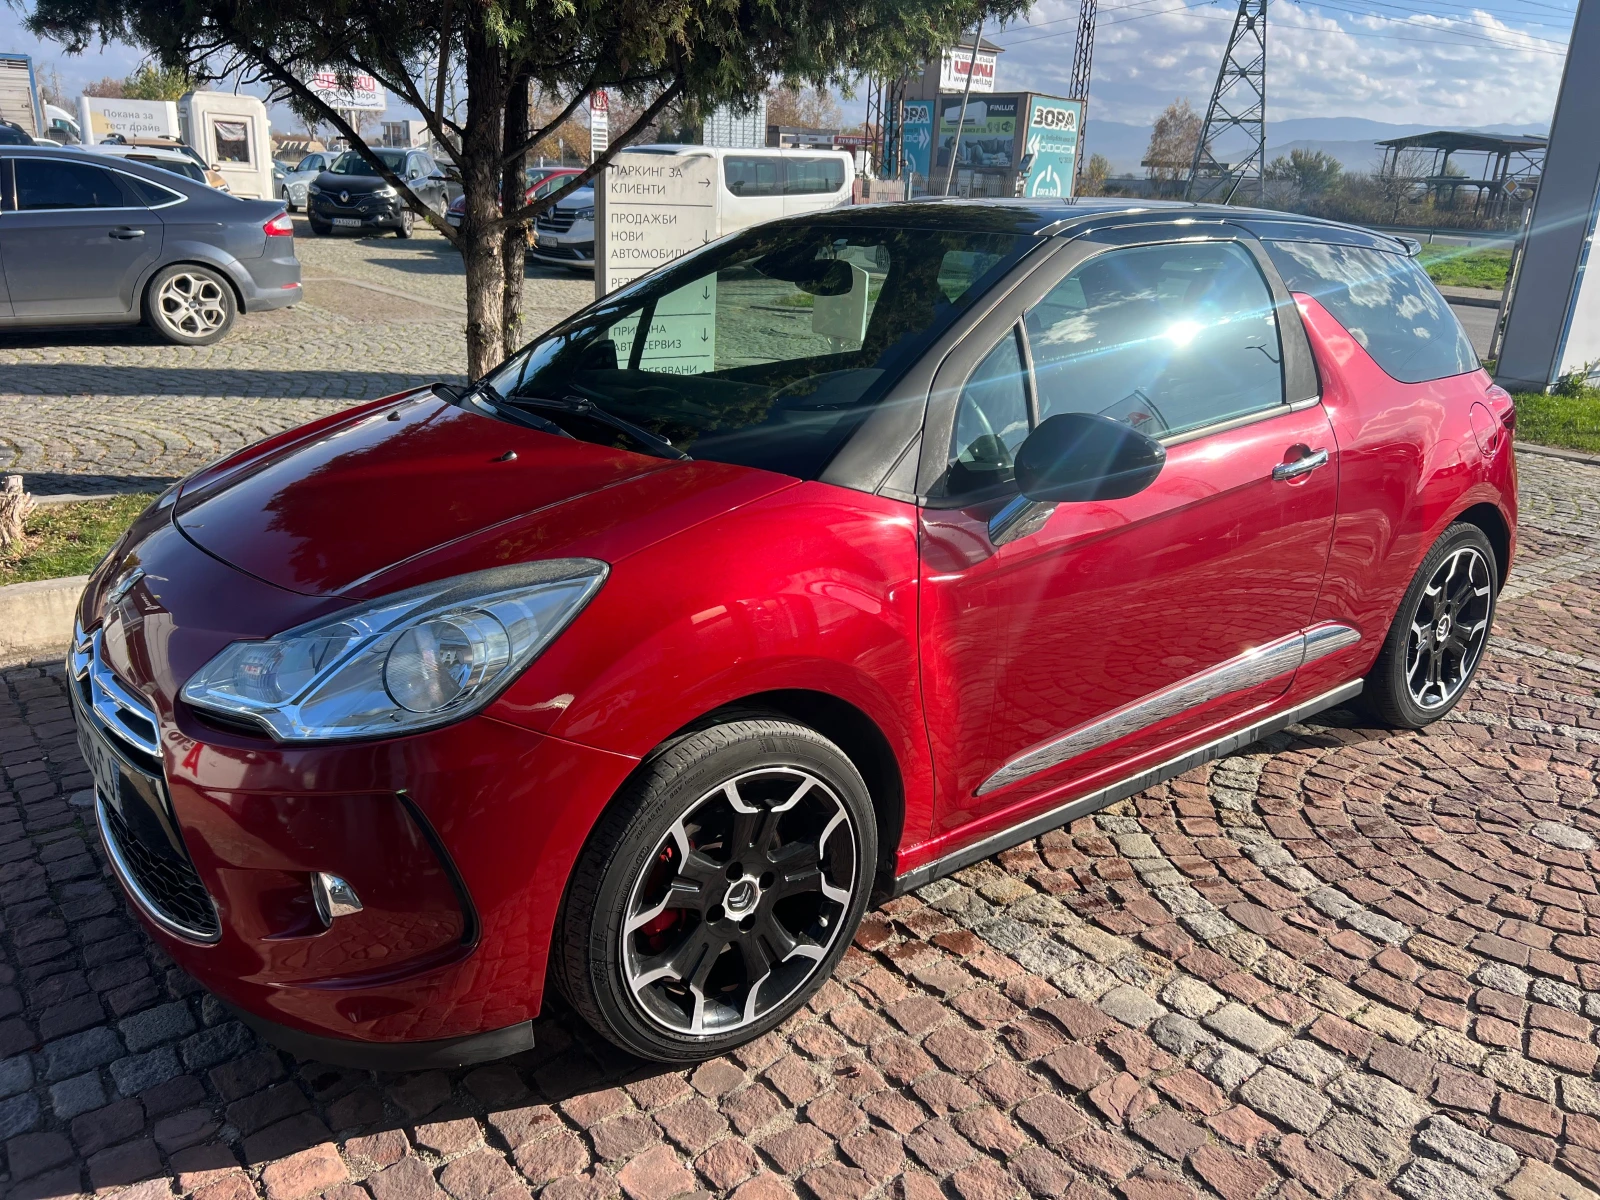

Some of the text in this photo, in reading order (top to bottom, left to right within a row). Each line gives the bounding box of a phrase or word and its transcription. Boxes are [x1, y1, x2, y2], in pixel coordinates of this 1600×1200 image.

[103, 109, 140, 119] Покана
[1032, 107, 1076, 131] ЗОРА
[105, 122, 160, 132] тест драйв
[611, 165, 683, 178] ПАРКИНГ ЗА
[611, 183, 666, 194] КЛИЕНТИ
[1037, 187, 1057, 197] zora.bg
[611, 213, 677, 225] ПРОДАЖБИ
[611, 231, 644, 241] НОВИ
[613, 325, 666, 336] ПРИНА
[615, 339, 681, 351] АВТСЕРВИЗ
